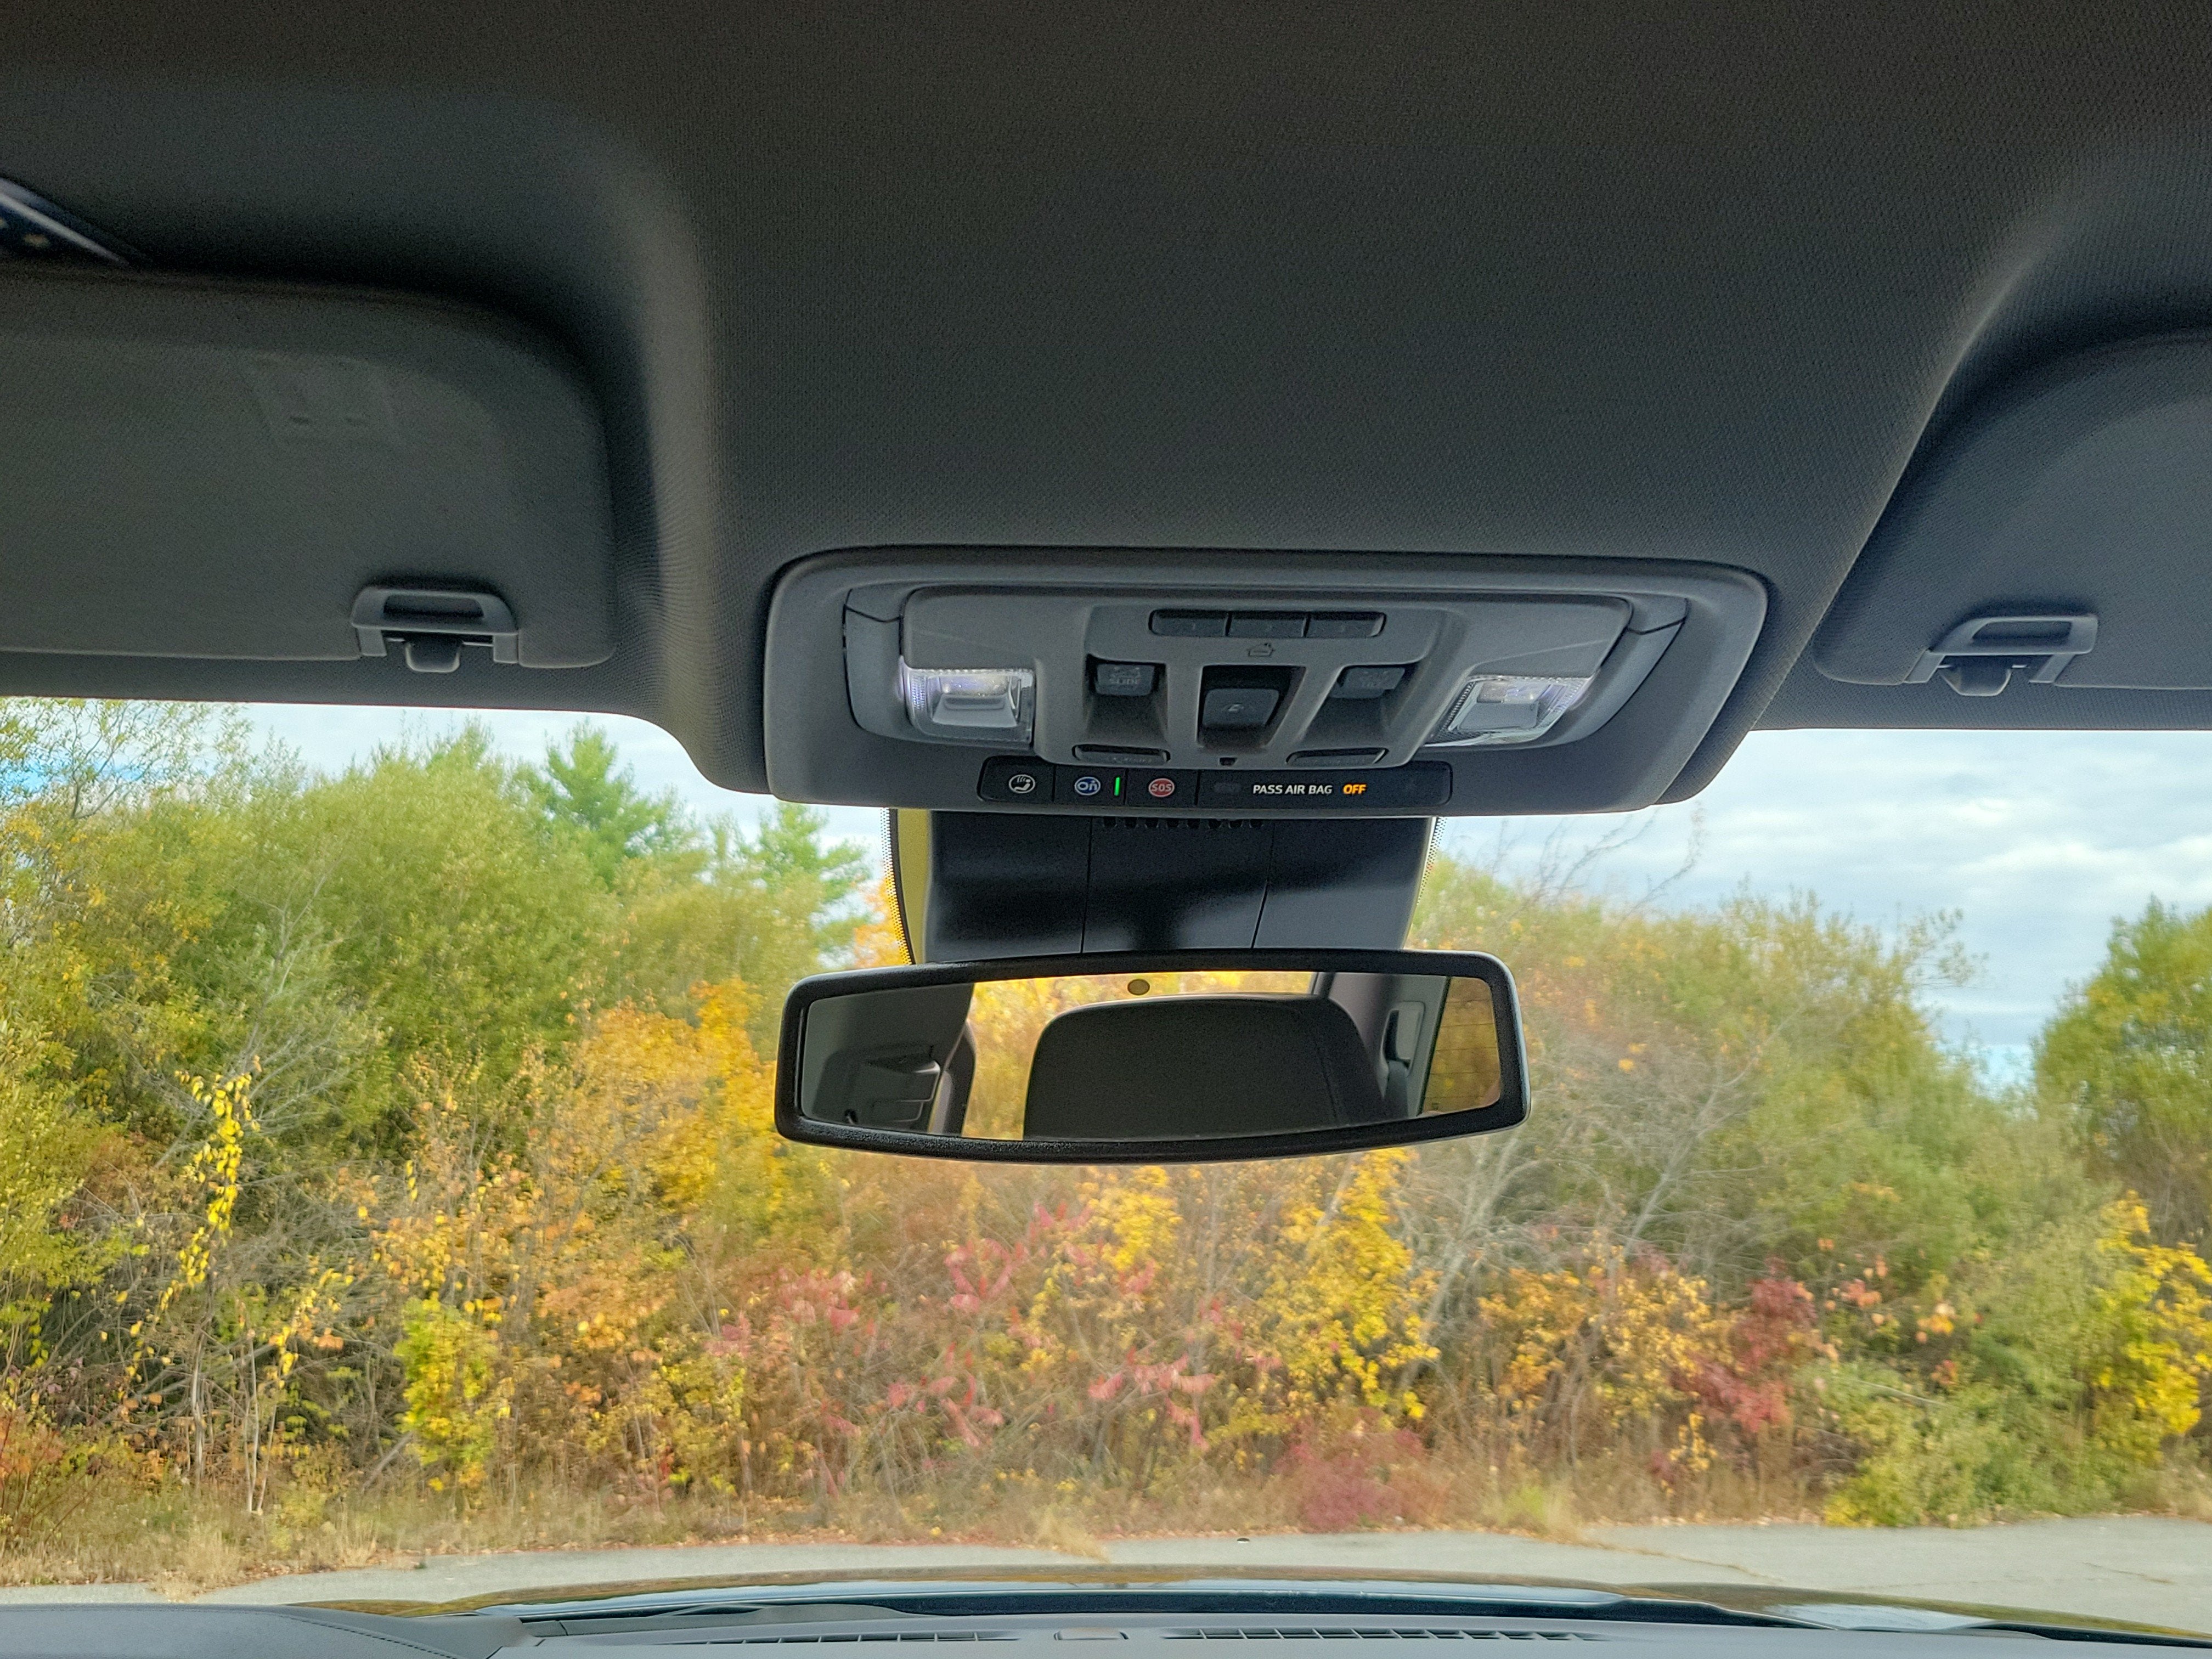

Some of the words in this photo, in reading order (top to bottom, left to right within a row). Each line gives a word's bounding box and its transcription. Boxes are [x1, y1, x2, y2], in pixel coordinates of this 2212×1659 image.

[1151, 784, 1172, 792] SOS
[1253, 785, 1283, 794] PASS
[1284, 785, 1306, 794] AIR
[1308, 785, 1333, 794] BAG
[1343, 784, 1367, 795] OFF
